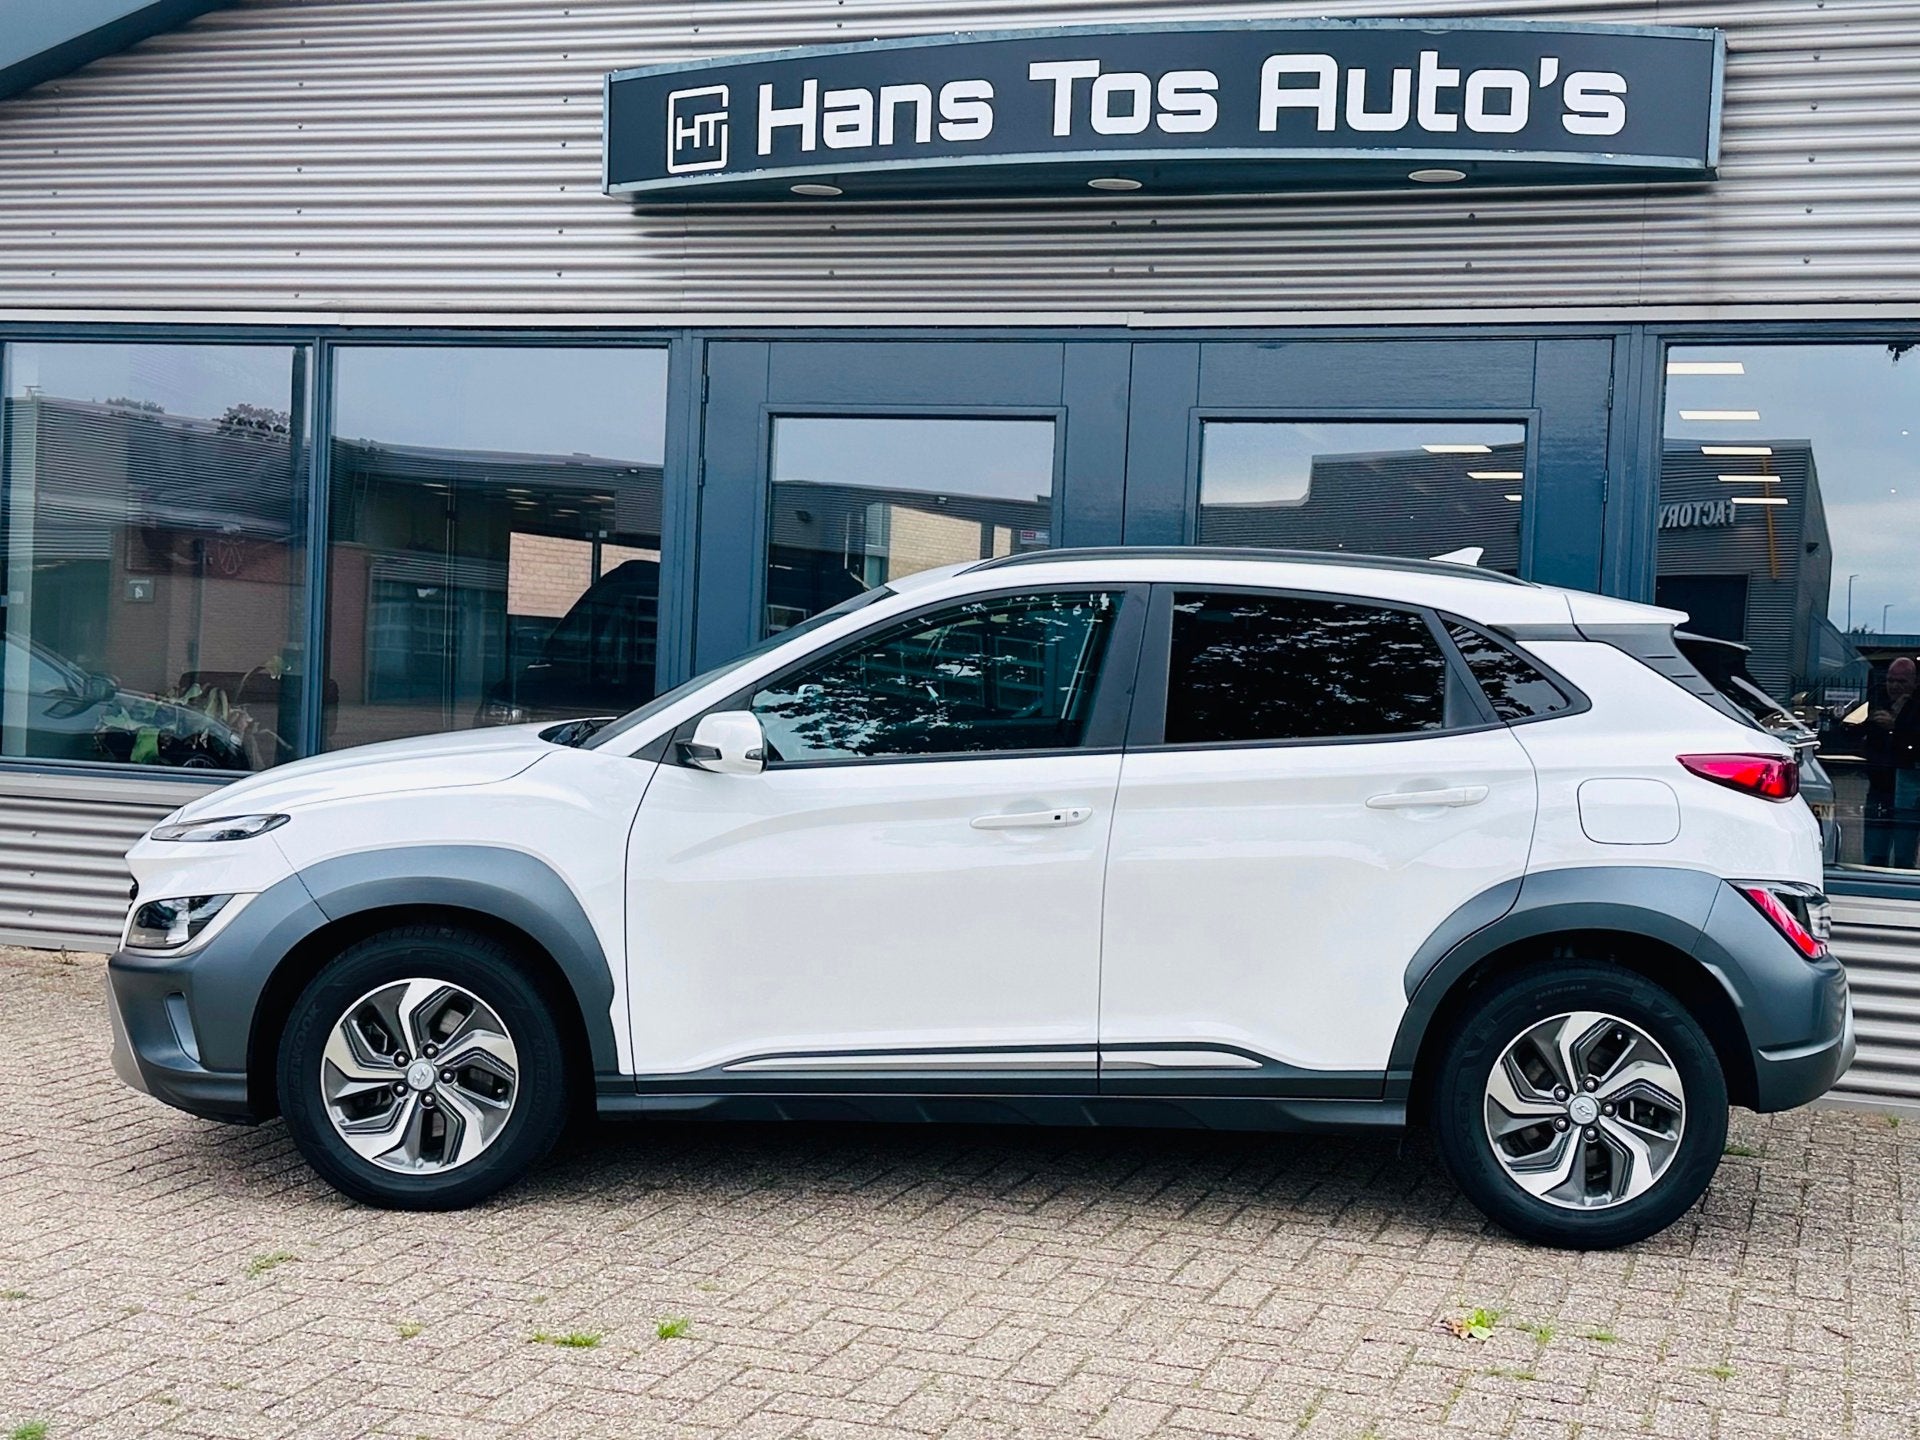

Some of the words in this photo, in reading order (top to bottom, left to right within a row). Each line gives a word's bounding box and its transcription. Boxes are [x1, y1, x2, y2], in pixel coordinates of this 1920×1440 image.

[757, 79, 994, 155] Hans
[1029, 60, 1219, 136] Tos
[1258, 51, 1627, 136] Auto's
